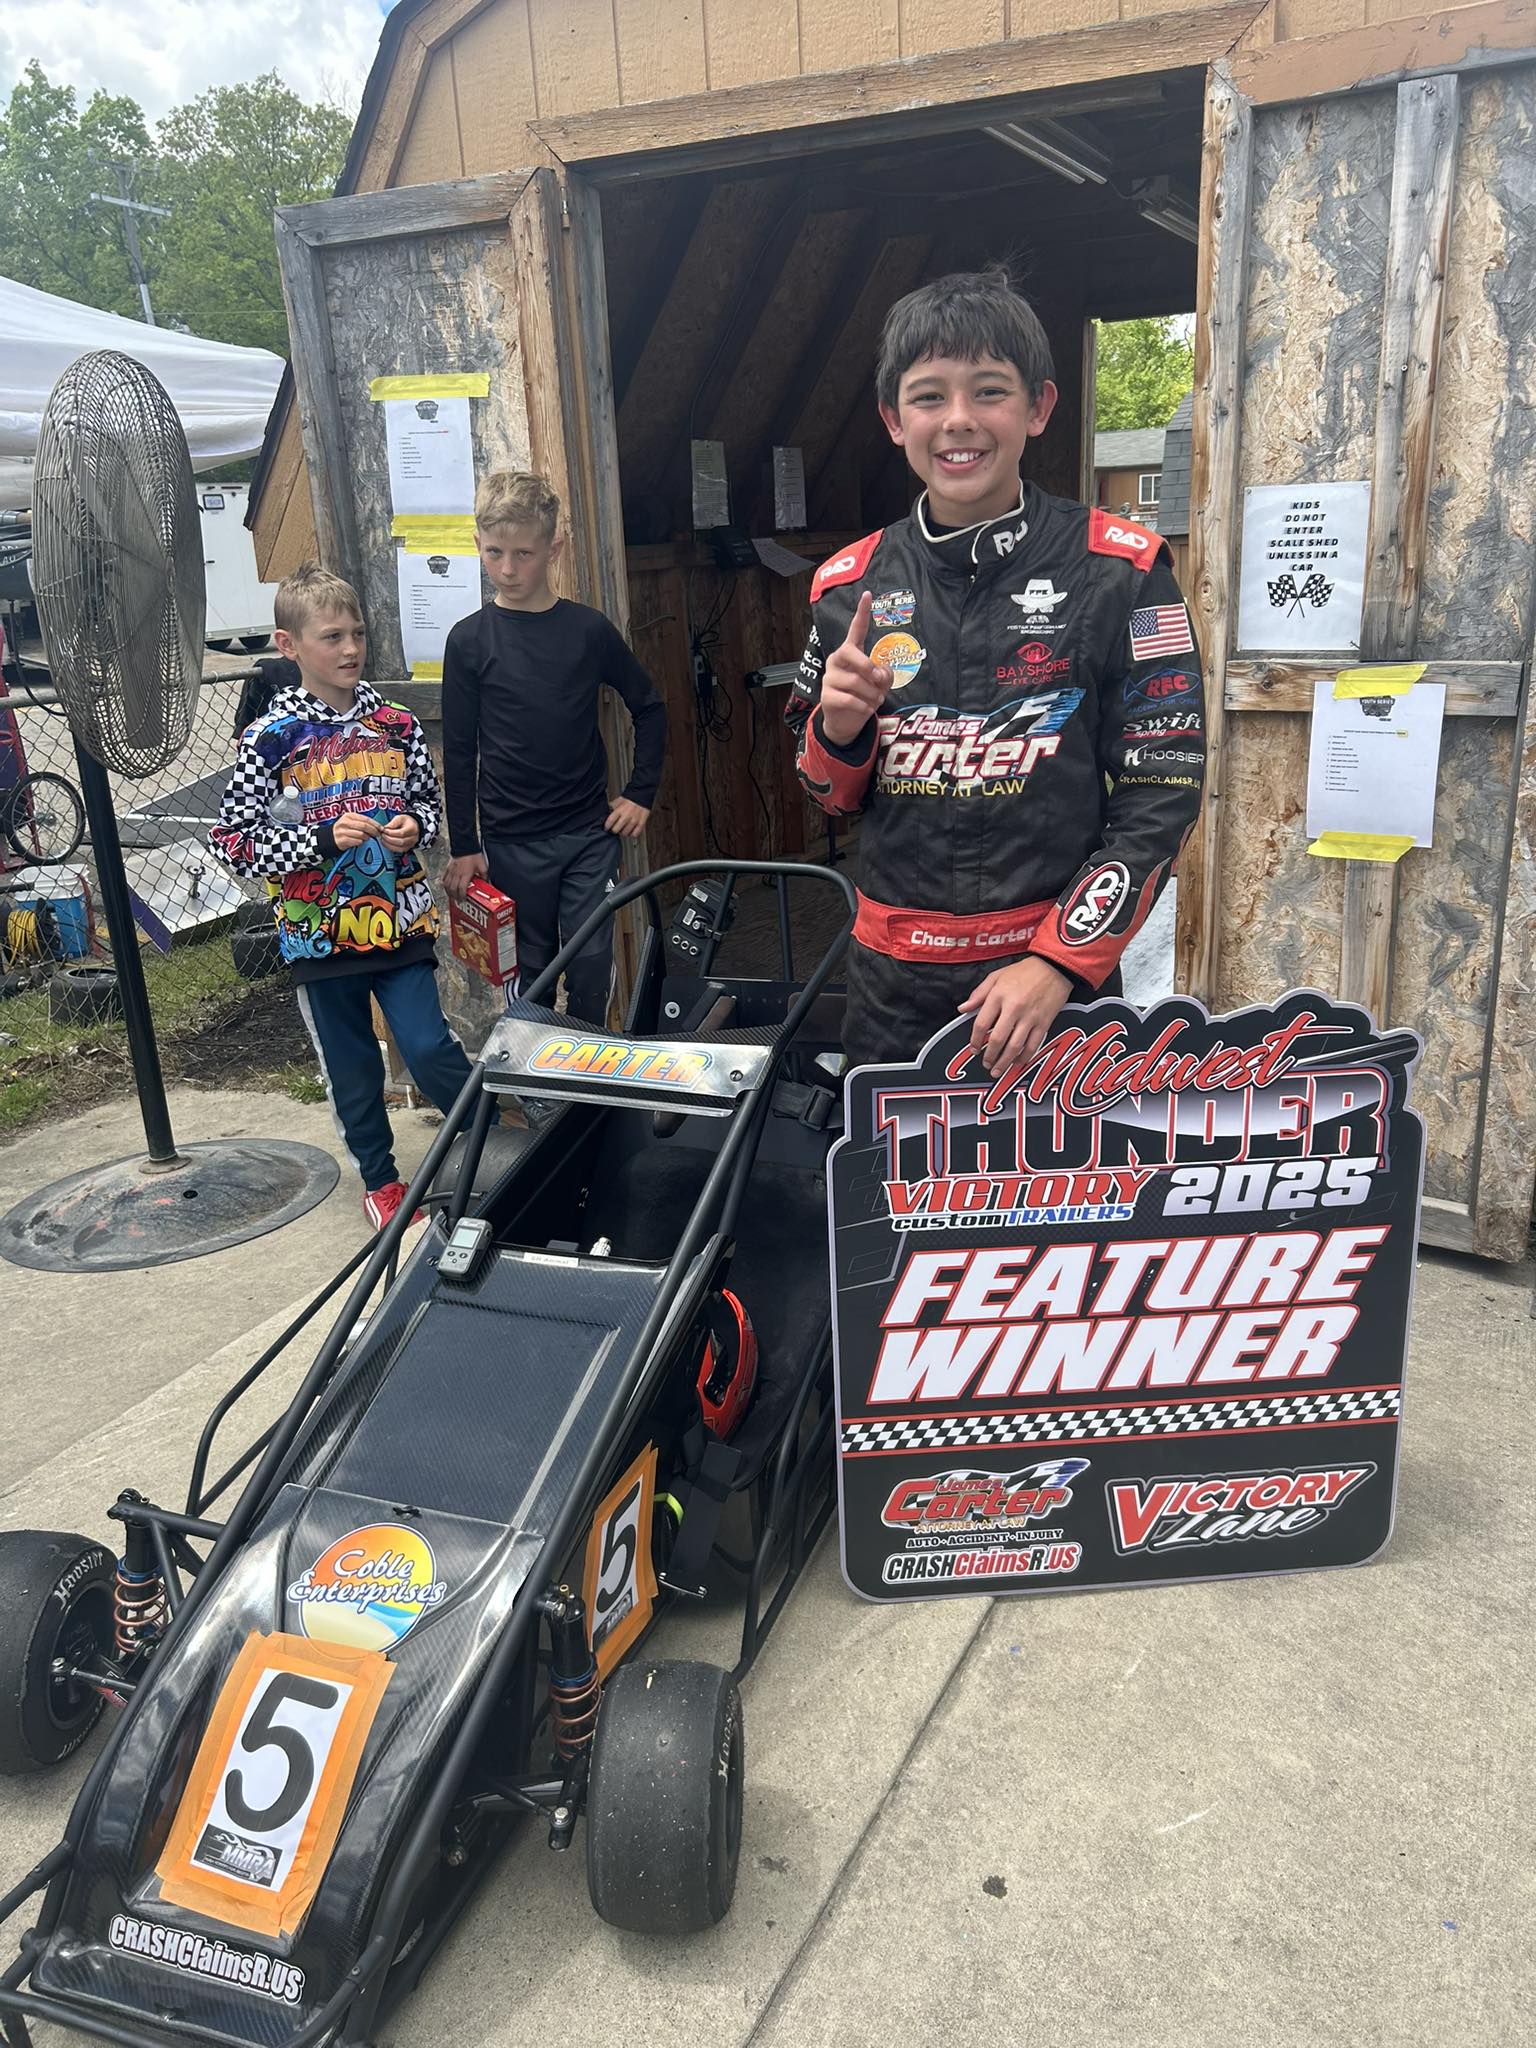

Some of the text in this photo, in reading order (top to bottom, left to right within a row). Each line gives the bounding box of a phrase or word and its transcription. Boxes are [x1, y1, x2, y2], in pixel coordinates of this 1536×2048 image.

[1284, 513, 1326, 523] DO NOT
[1291, 501, 1320, 510] KIDS
[1104, 526, 1149, 550] RAD
[1269, 538, 1339, 548] SCALE SHED
[1286, 526, 1323, 535] ENTER
[820, 555, 856, 582] RAD
[1268, 550, 1339, 560] UNLESS IN A
[1291, 563, 1314, 572] CAR
[996, 657, 1071, 679] BAYSHORE
[1030, 673, 1054, 684] CARE
[1145, 674, 1189, 698] RFC
[900, 712, 984, 737] James
[287, 727, 390, 770] Midwest
[1143, 750, 1205, 765] HOOSIER
[951, 781, 972, 797] AT
[981, 778, 1026, 796] LAW
[1065, 870, 1120, 931] RAD
[1087, 881, 1126, 934] RACE GEAR
[910, 924, 1035, 947] Chase Carter
[534, 1040, 706, 1083] CARTER
[947, 1011, 1354, 1114] Midwest
[873, 1064, 1391, 1181] THUNDER
[883, 1157, 1380, 1217] VICTORY 2025
[879, 1225, 1391, 1328] FEATURE
[866, 1304, 1361, 1405] WINNER
[938, 1477, 1004, 1493] James
[882, 1479, 1068, 1523] Carter
[1112, 1468, 1369, 1549] VICTORY
[906, 1529, 1063, 1548] AUTO ACCIDENT INJURY
[915, 1517, 1026, 1534] ATTORNEY AT LAW
[1152, 1506, 1321, 1547] Lane
[596, 1480, 641, 1613] 5
[333, 1549, 415, 1580] Coble
[885, 1543, 1078, 1582] CRASHClaimsR.US
[288, 1569, 446, 1615] Enterprises
[225, 1671, 338, 1833] 5
[110, 1915, 303, 2001] CRASHClaimsR.US
